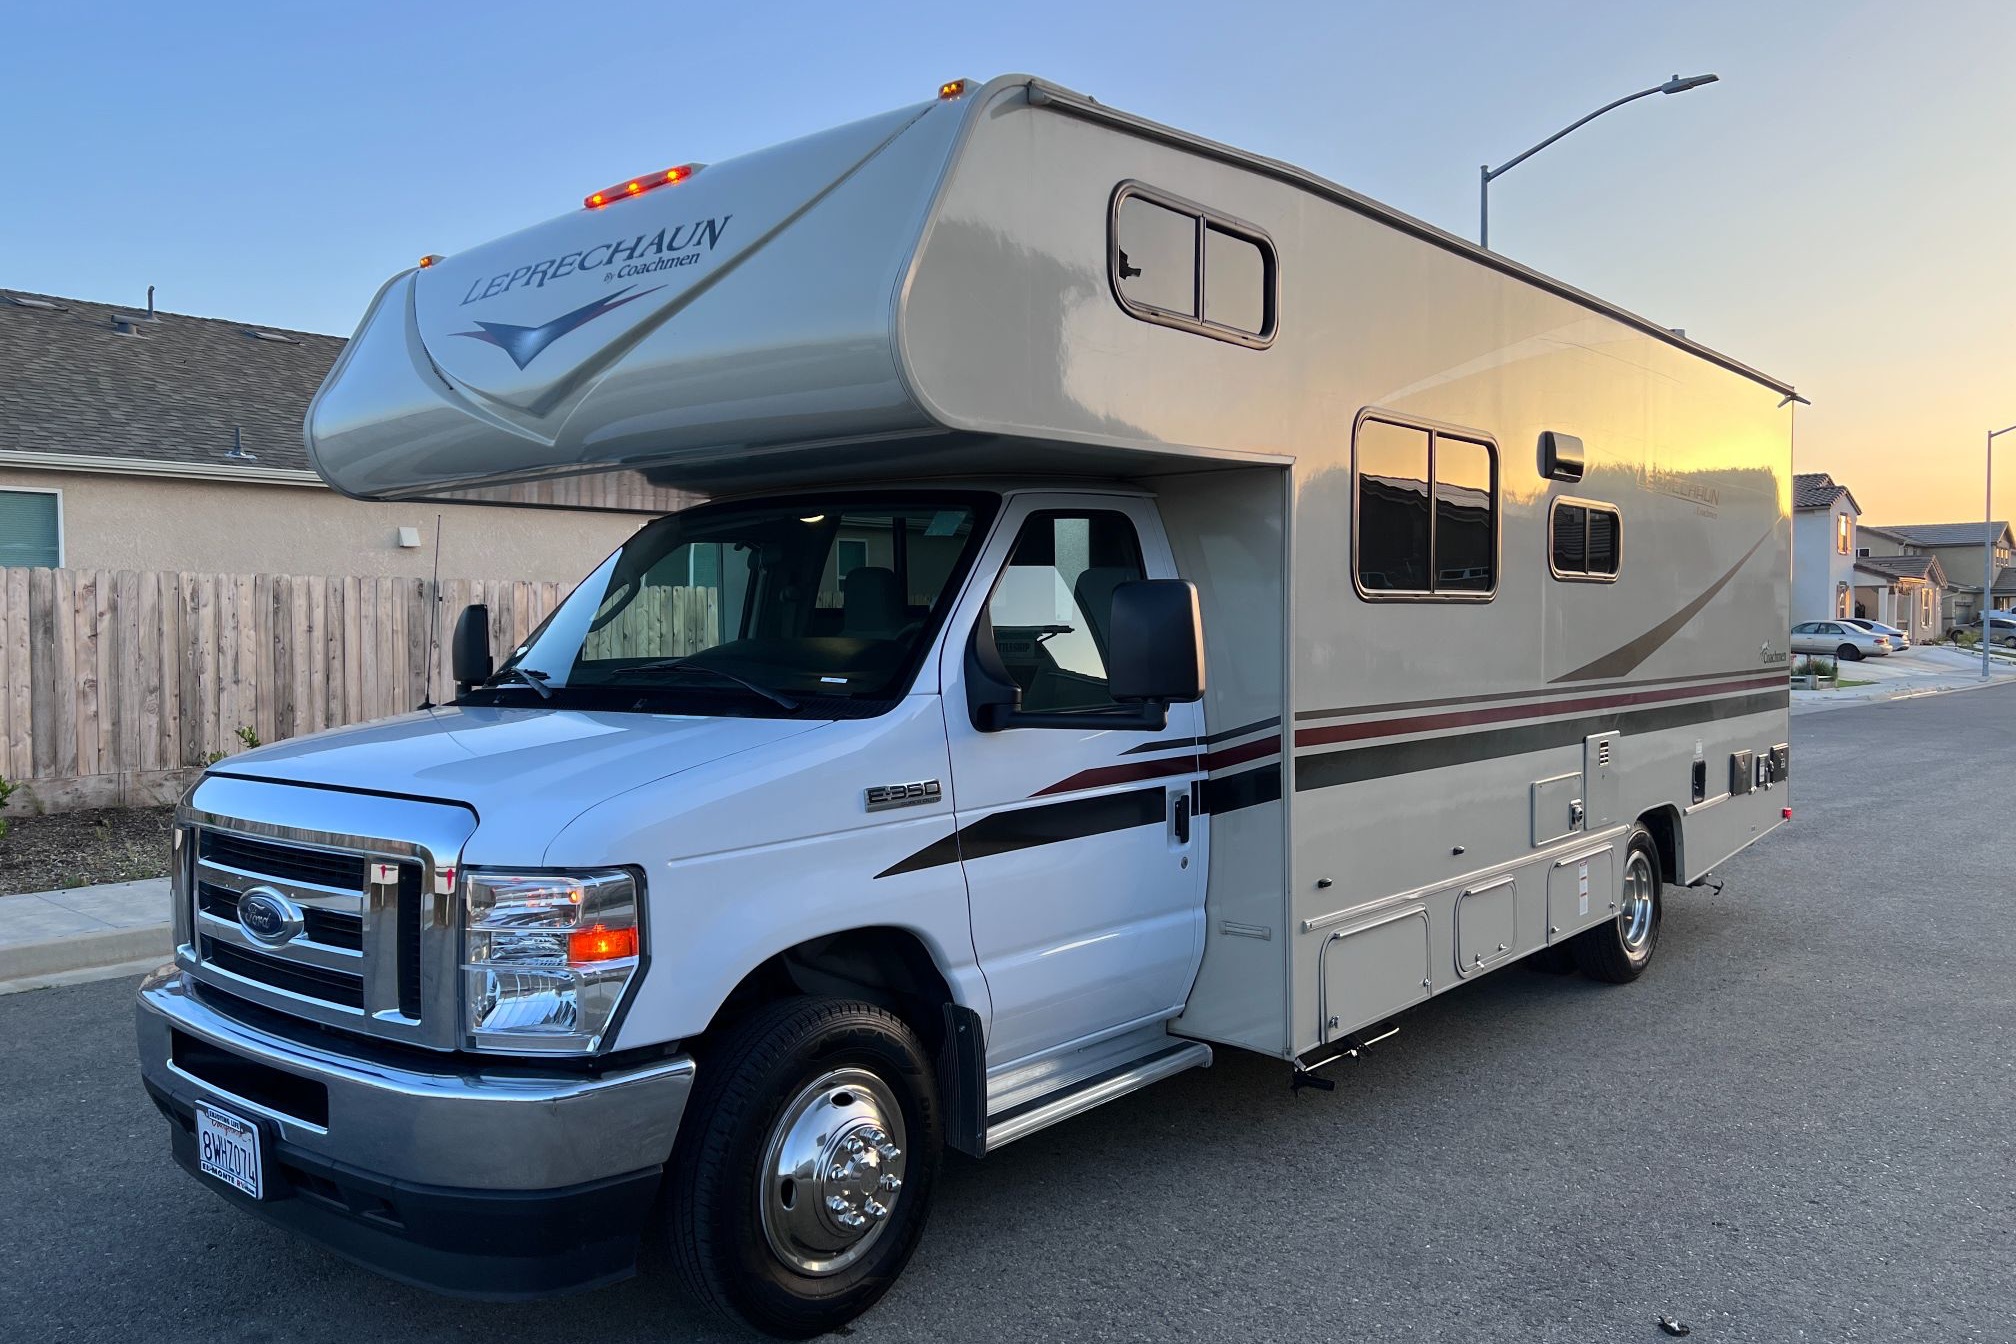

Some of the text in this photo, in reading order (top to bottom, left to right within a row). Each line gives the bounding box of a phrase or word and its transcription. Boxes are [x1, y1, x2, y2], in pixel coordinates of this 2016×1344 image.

[459, 214, 733, 306] LEPRECHAUN
[617, 252, 701, 279] Coachmen
[245, 903, 272, 929] Ford
[230, 1119, 240, 1129] LIFE
[211, 1166, 235, 1184] MONTE
